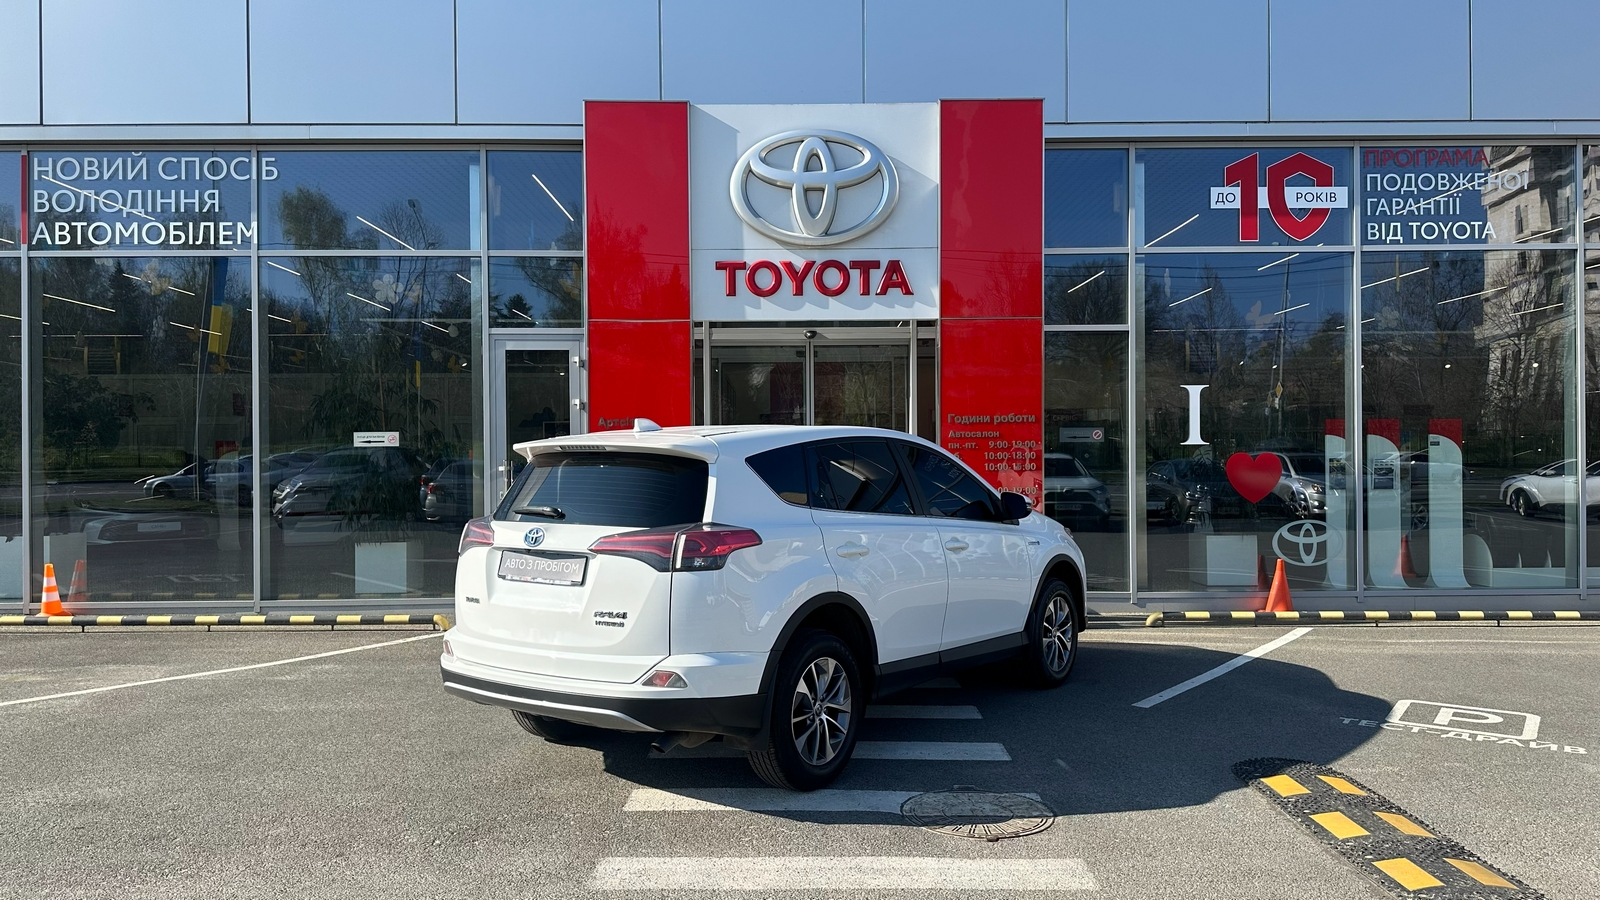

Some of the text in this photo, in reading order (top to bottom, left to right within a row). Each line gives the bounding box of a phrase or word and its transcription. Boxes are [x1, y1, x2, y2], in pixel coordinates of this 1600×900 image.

[33, 151, 279, 181] НОВИЙ СПОСІБ
[1365, 148, 1490, 167] ПРОГРАМА
[33, 189, 220, 218] ВОЛОДІННЯ
[1215, 192, 1236, 205] ДО
[1295, 192, 1337, 203] РОКІВ
[1367, 193, 1462, 216] ГАРАНТІЇ
[31, 221, 258, 246] АВТОМОБІЛЕМ
[1367, 221, 1497, 244] ВІД TOYOTA
[715, 259, 914, 298] TOYOTA
[947, 412, 1036, 425] Години роботи
[1180, 384, 1210, 445] I
[948, 429, 1000, 438] Автосалон
[988, 440, 1036, 449] 9:00-19:00
[984, 452, 1036, 460] 10:00-18:00
[504, 558, 526, 569] АВТО
[534, 560, 580, 574] ПРОБІГОМ
[1338, 716, 1588, 755] ТЕСТ-ДРАЙВ
